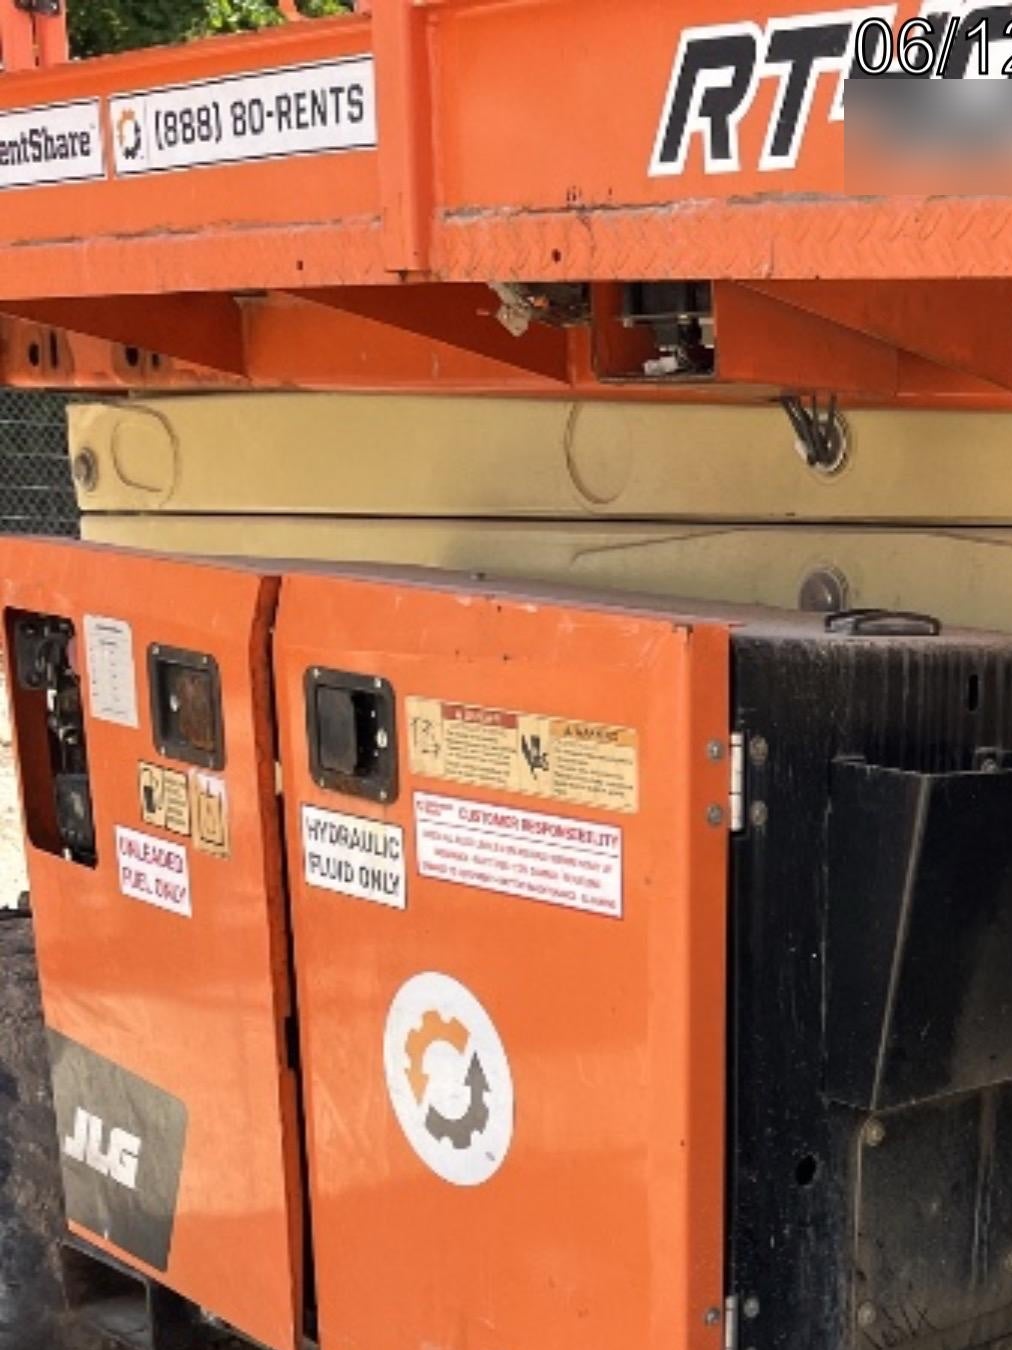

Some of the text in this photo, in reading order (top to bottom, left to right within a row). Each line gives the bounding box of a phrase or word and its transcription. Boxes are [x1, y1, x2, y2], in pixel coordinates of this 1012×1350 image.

[154, 83, 365, 151] (888) 80-RENTS
[305, 816, 400, 860] HYDRAULIC
[308, 851, 355, 883] FLUID
[359, 866, 400, 896] ONLY
[65, 1107, 142, 1189] JLG
